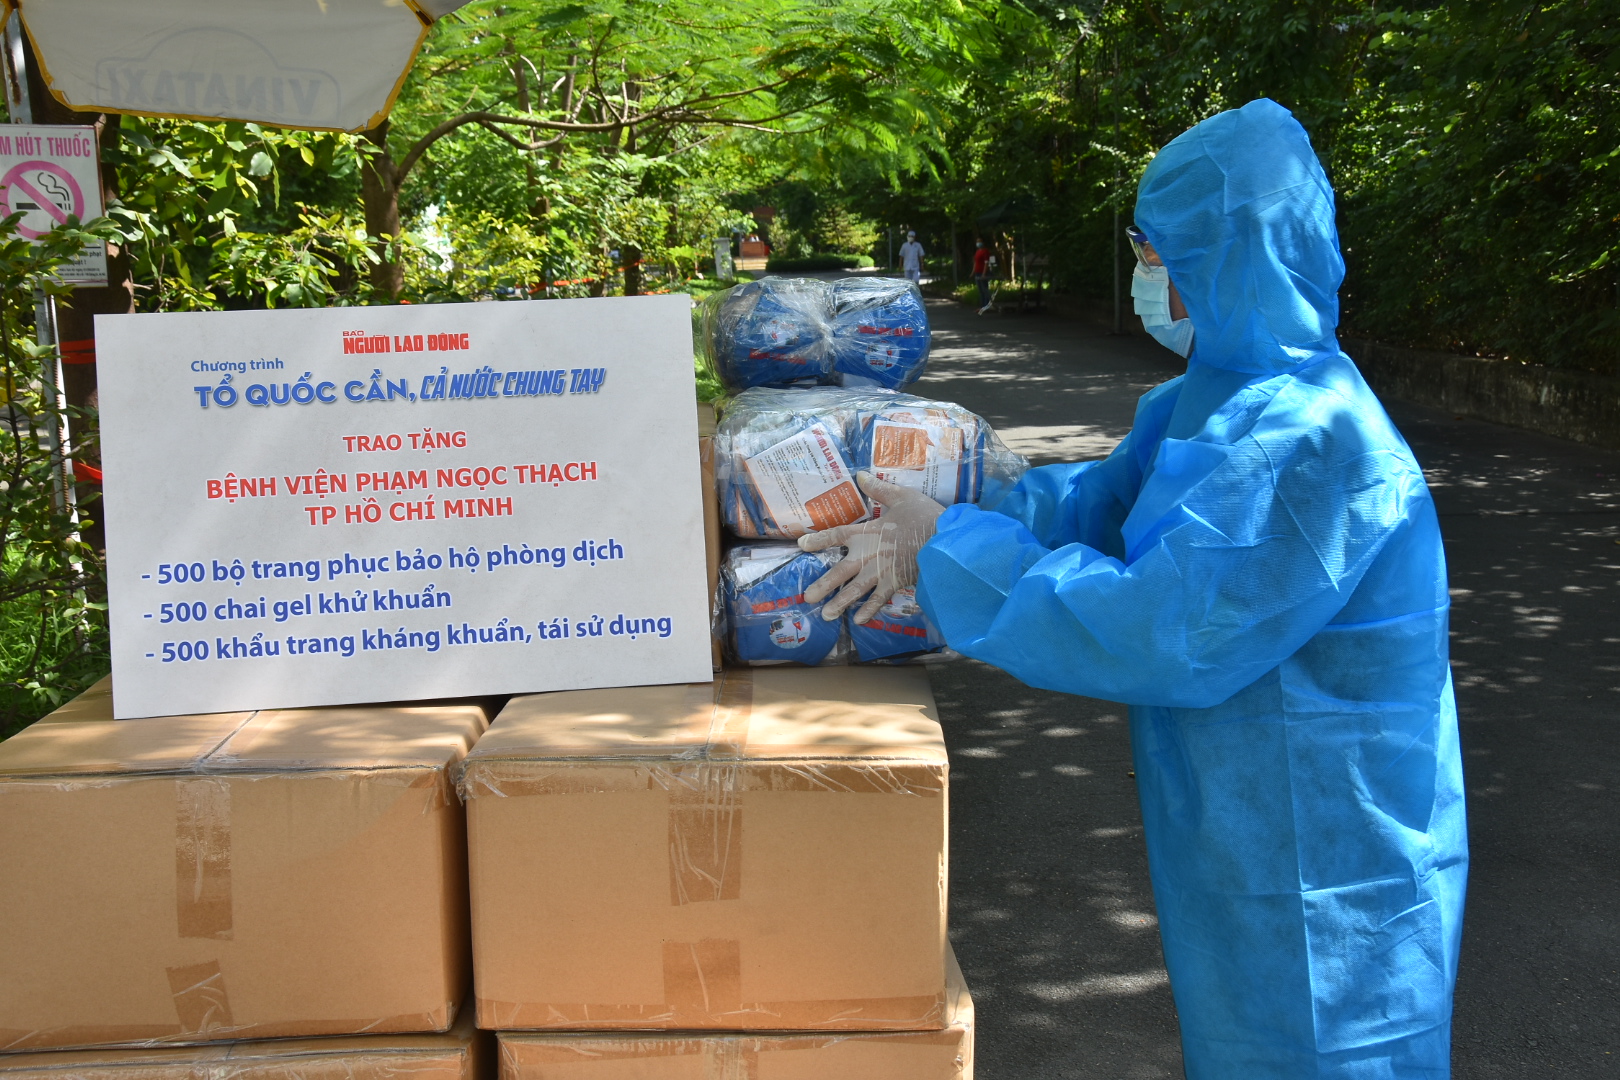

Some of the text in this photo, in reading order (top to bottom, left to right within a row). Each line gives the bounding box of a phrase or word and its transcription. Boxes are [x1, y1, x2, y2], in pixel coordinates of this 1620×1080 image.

[15, 132, 42, 156] HÚT
[47, 132, 91, 157] THUỐC
[342, 332, 471, 355] NGƯỜI LAO ĐỘNG
[190, 357, 286, 377] Chương trình
[193, 365, 607, 409] TỔ QUỐC CẦN, CẢ NƯỚC CHUNG TAY
[342, 427, 467, 454] TRAO TẶNG
[207, 461, 597, 503] BỆNH VIỆN PHẠM NGỌC THẠCH
[304, 494, 513, 526] TP HỒ CHÍ MINH
[158, 562, 206, 585] 500
[212, 559, 246, 586] bộ
[251, 560, 321, 582] trang
[327, 553, 390, 581] phục
[395, 548, 443, 571] bảo
[448, 546, 481, 573] hộ
[487, 543, 567, 572] phòng
[572, 538, 624, 567] dịch
[160, 601, 208, 624] 500
[214, 596, 267, 620] chai
[273, 593, 312, 623] gel
[318, 589, 369, 614] khử
[373, 583, 452, 611] khuẩn
[162, 640, 210, 663] 500
[216, 632, 280, 659] khẩu
[286, 636, 355, 658] trang
[362, 628, 441, 652] kháng
[447, 617, 532, 645] khuẩn,
[537, 617, 570, 640] tái
[575, 614, 605, 638] sử
[609, 614, 672, 640] dụng
